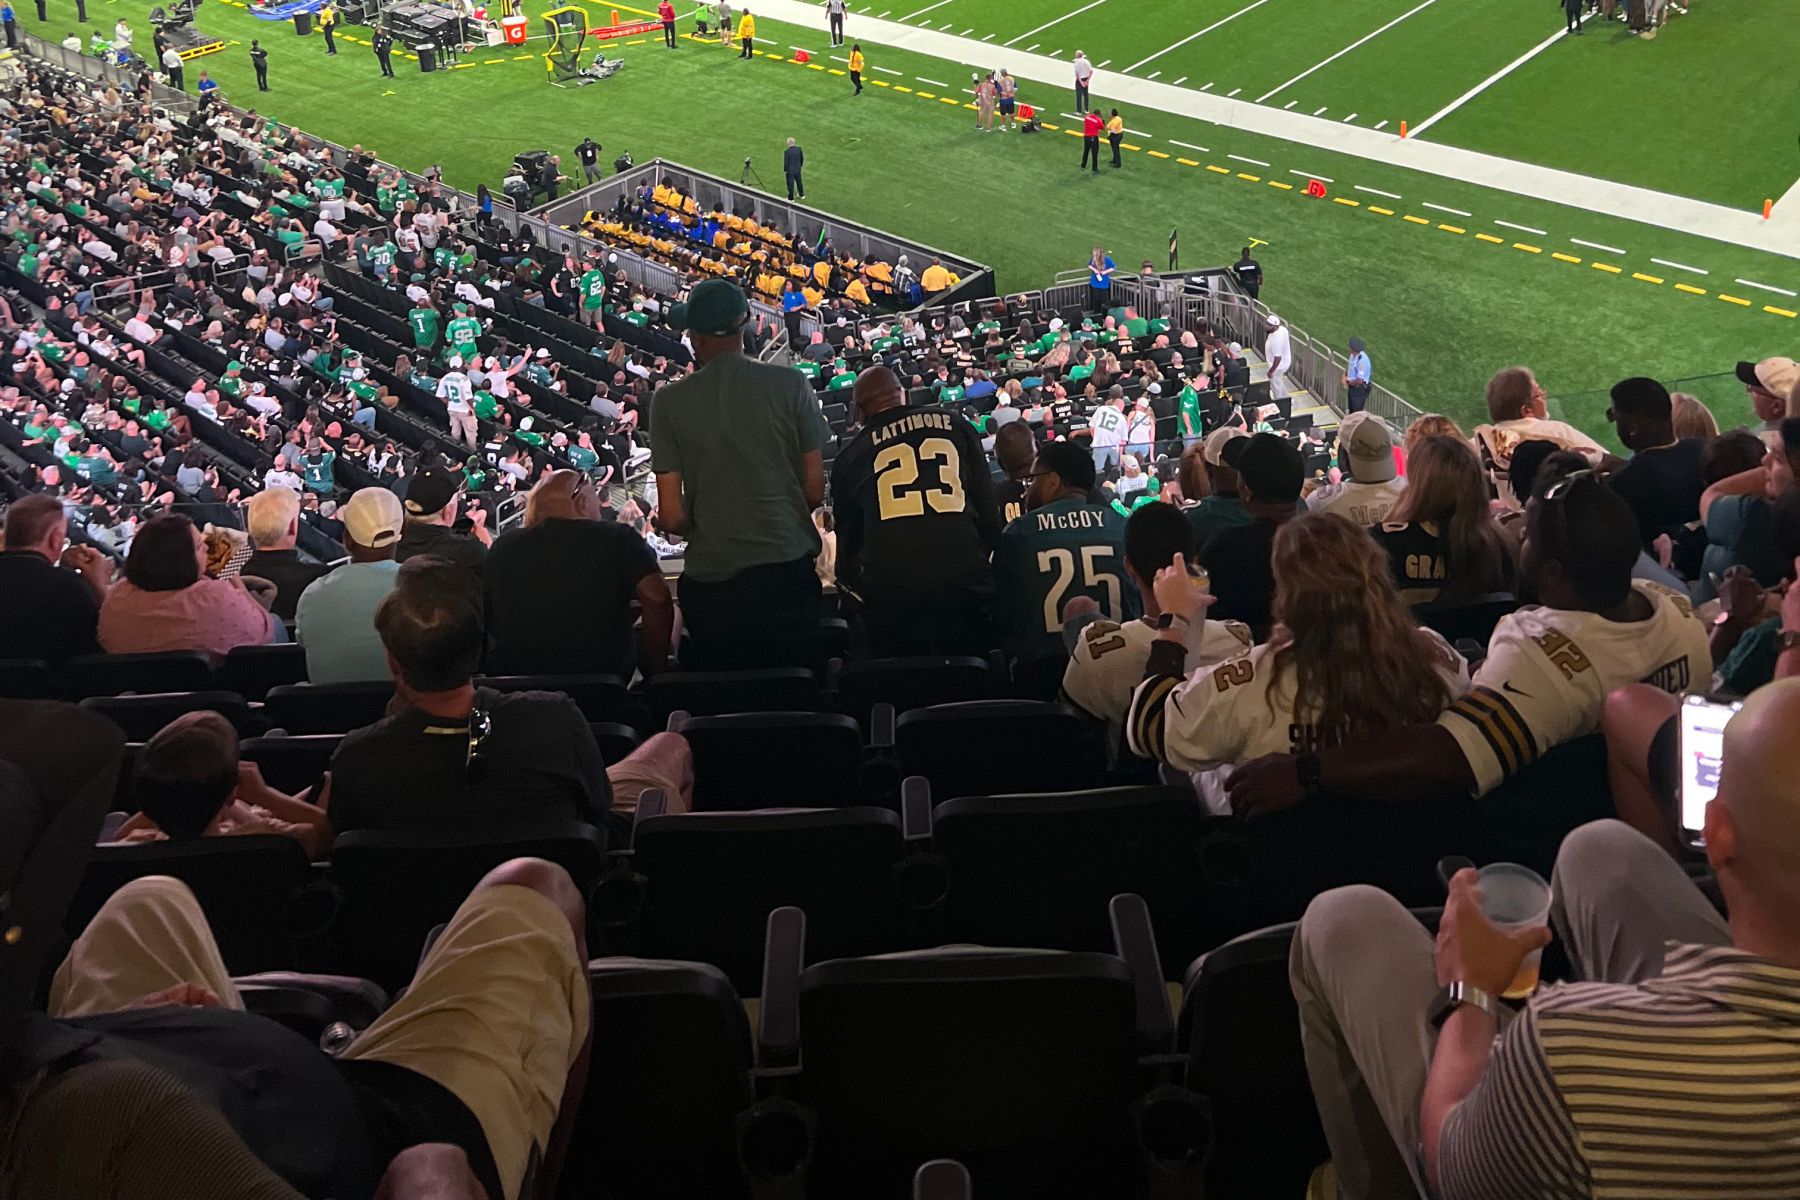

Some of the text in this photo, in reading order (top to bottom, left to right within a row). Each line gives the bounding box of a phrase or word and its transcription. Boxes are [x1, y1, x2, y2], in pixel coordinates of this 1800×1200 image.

[511, 27, 522, 39] G
[590, 280, 602, 296] 62
[416, 318, 426, 333] 1
[454, 328, 474, 345] 92
[446, 385, 461, 404] 12
[871, 413, 953, 447] LATTIMORE
[1100, 411, 1119, 433] 12
[313, 470, 321, 482] 1
[874, 437, 966, 521] 23
[1036, 545, 1122, 634] 25
